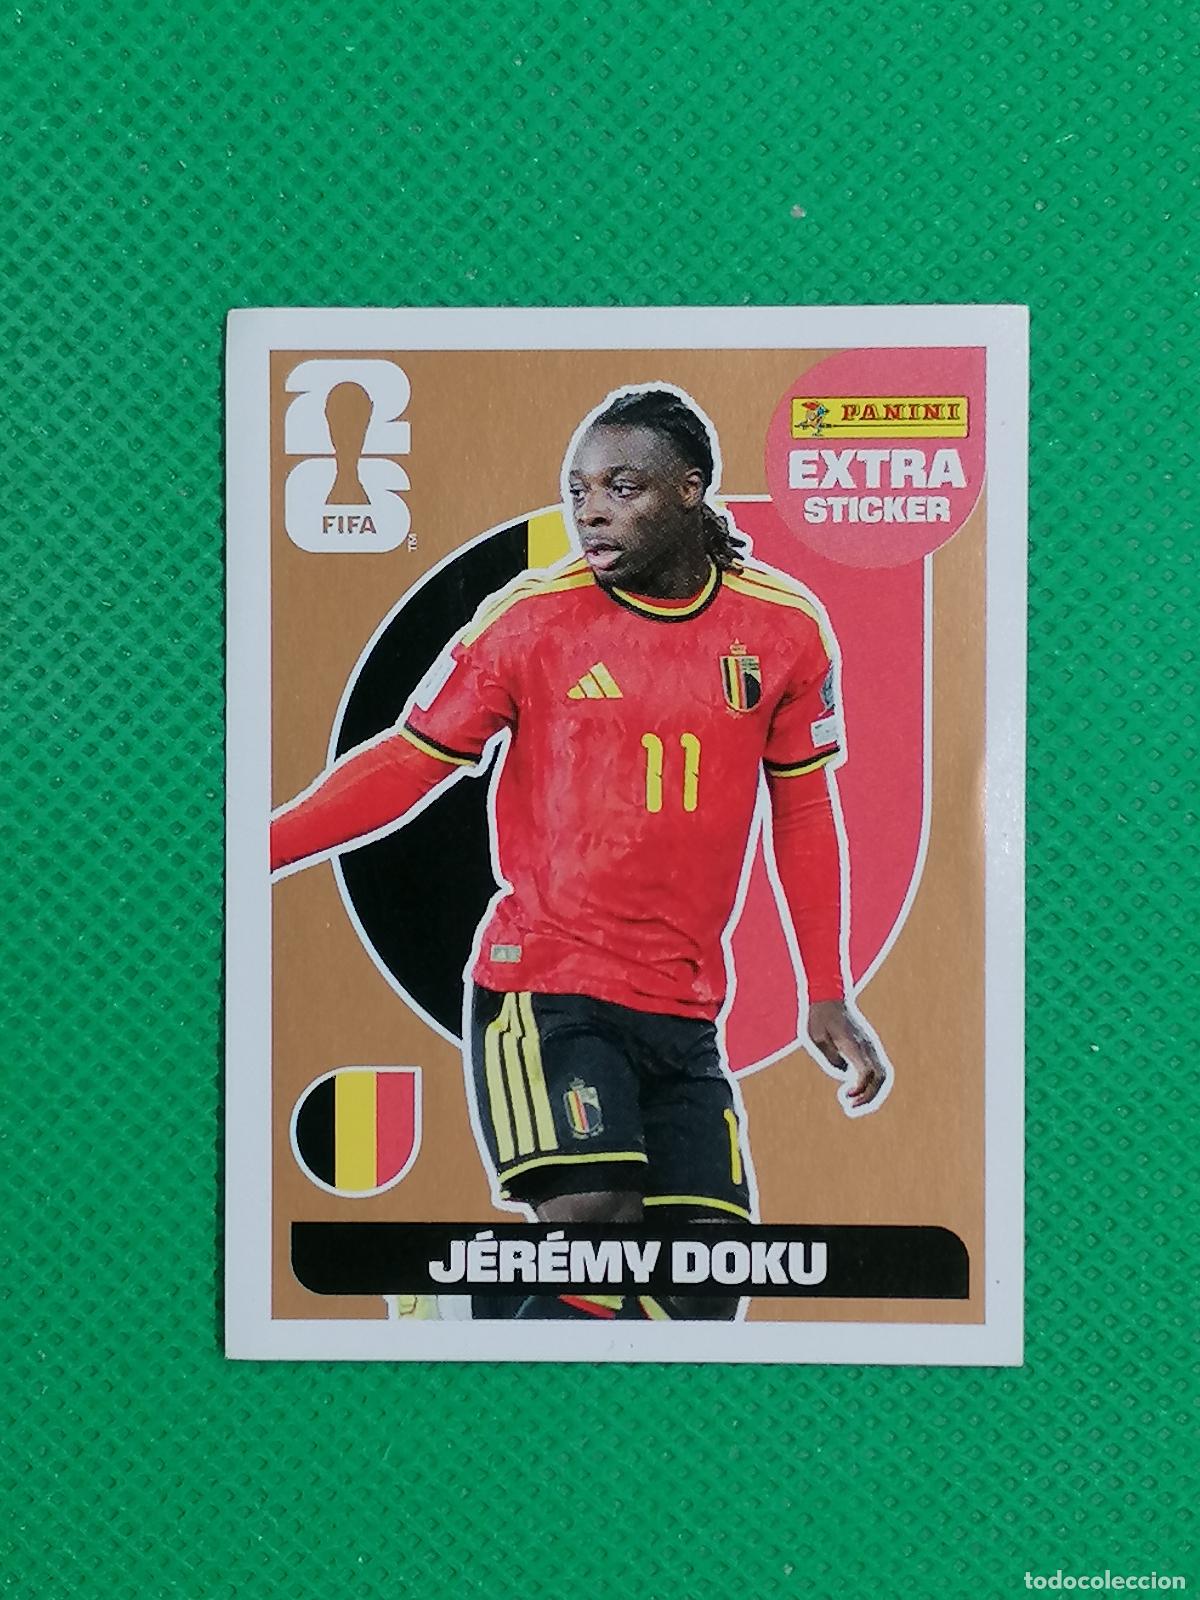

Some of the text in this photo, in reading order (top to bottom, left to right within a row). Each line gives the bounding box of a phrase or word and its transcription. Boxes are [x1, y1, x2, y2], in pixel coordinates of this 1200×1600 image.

[841, 403, 961, 421] PANINI
[788, 448, 968, 490] EXTRA
[322, 515, 377, 534] FIFA
[803, 496, 951, 524] STICKER
[641, 732, 701, 813] 11
[428, 1230, 828, 1286] JÉRÉMY DOKU
